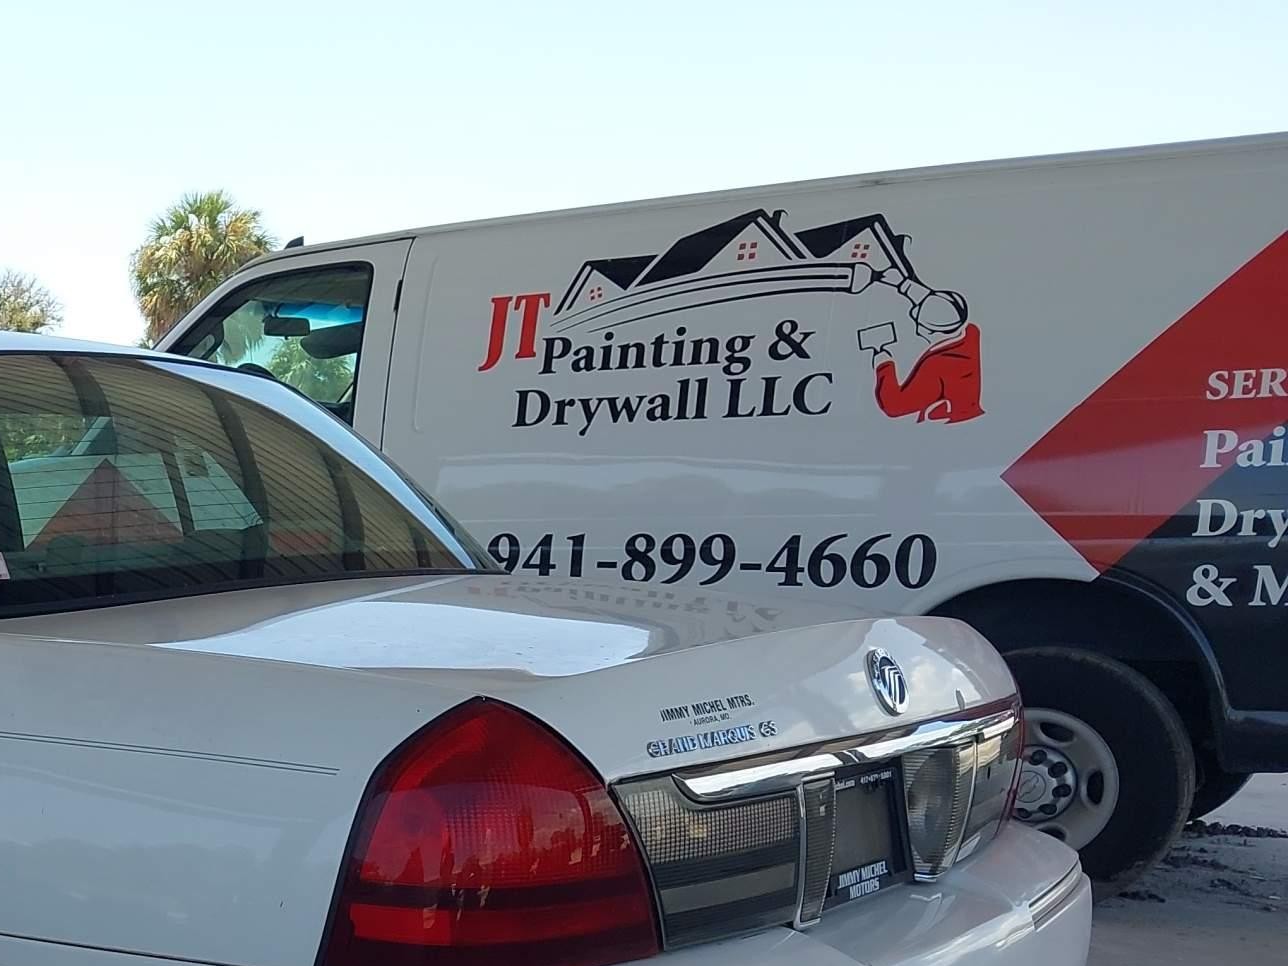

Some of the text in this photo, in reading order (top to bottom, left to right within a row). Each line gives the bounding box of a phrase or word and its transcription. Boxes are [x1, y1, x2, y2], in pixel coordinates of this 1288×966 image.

[478, 292, 552, 372] JT
[538, 319, 817, 376] Painting &
[511, 372, 834, 437] Drywall LLC
[487, 532, 938, 589] 941-899-4660
[1186, 564, 1238, 608] &
[660, 693, 755, 722] JIMMY MICHEL MTRS.
[646, 736, 698, 758] GRAND
[696, 724, 756, 750] MARQUIS
[849, 877, 880, 900] MOTORS
[859, 860, 888, 880] MICHEL
